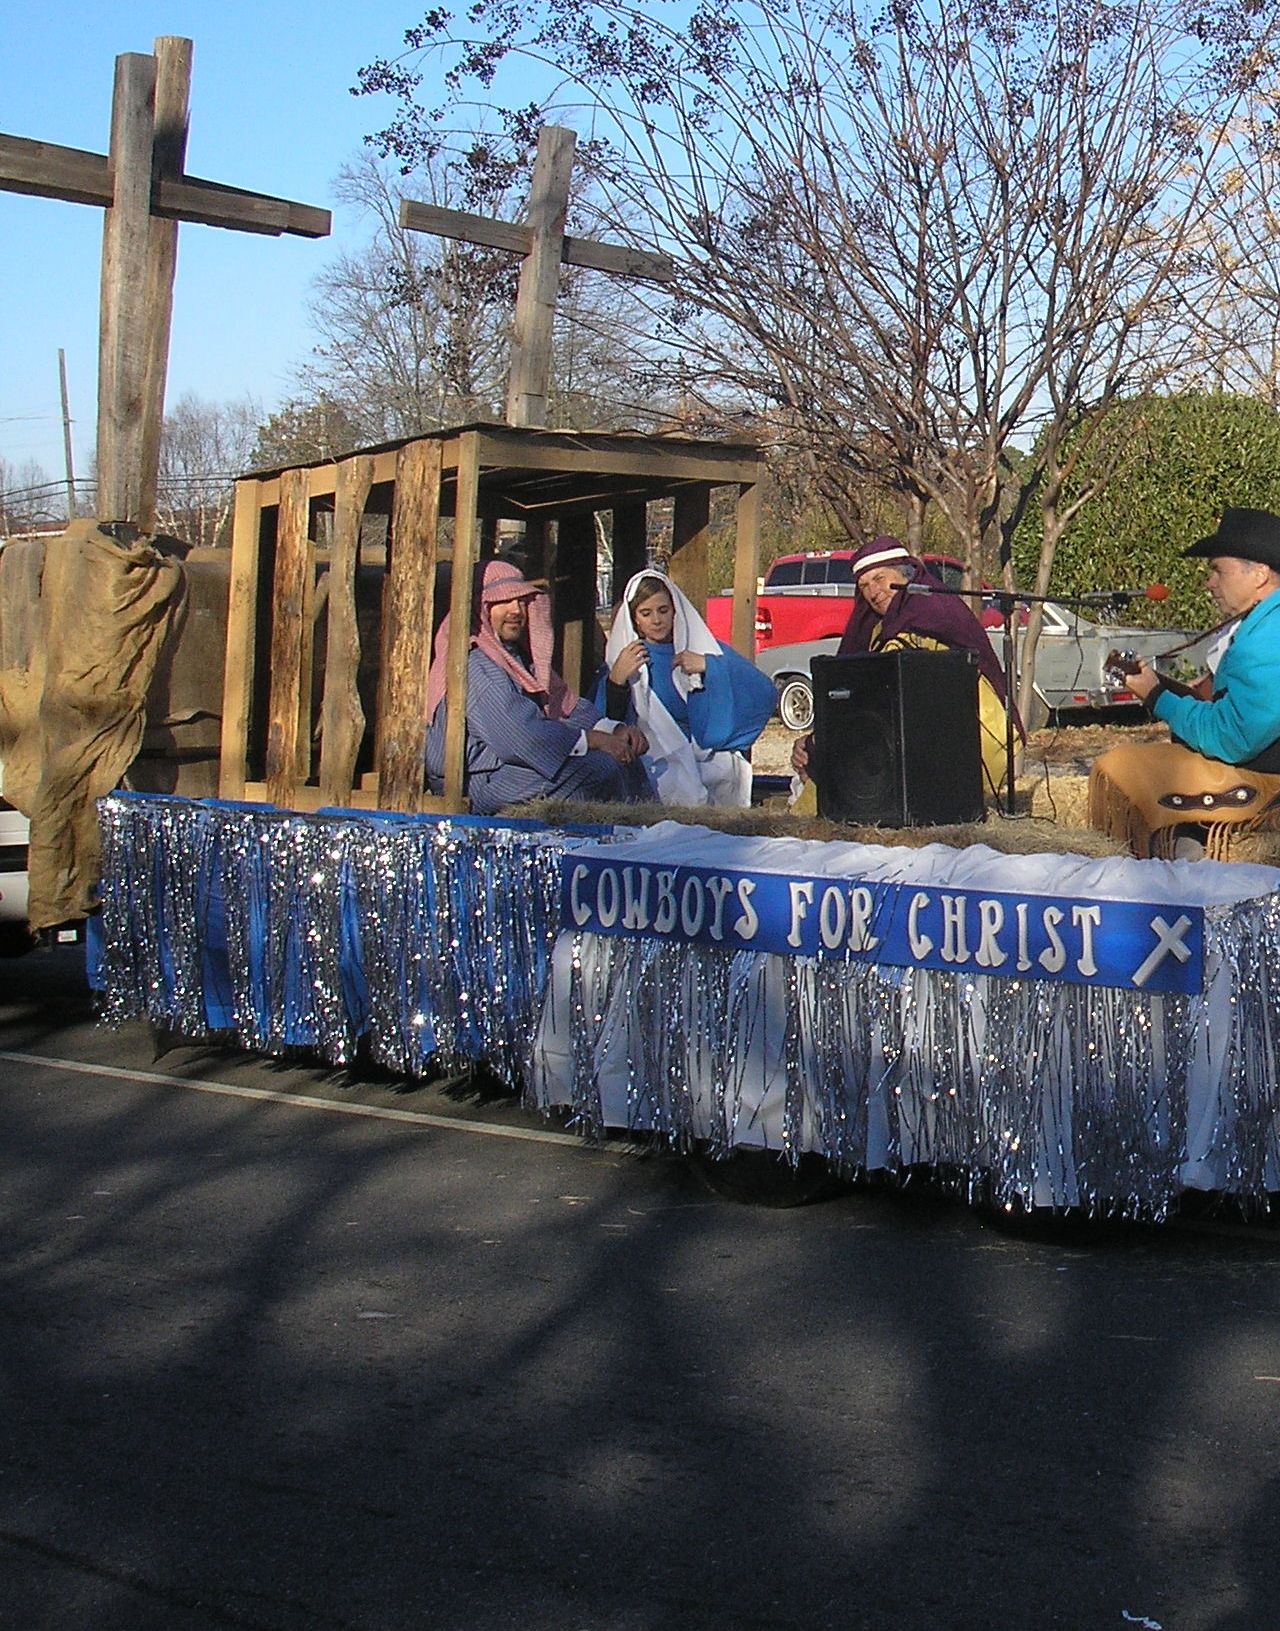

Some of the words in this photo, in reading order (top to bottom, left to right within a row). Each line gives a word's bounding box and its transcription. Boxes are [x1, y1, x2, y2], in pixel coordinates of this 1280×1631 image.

[570, 863, 759, 941] COWBOYS
[786, 881, 880, 952] FOR
[907, 892, 1101, 977] CHRIST
